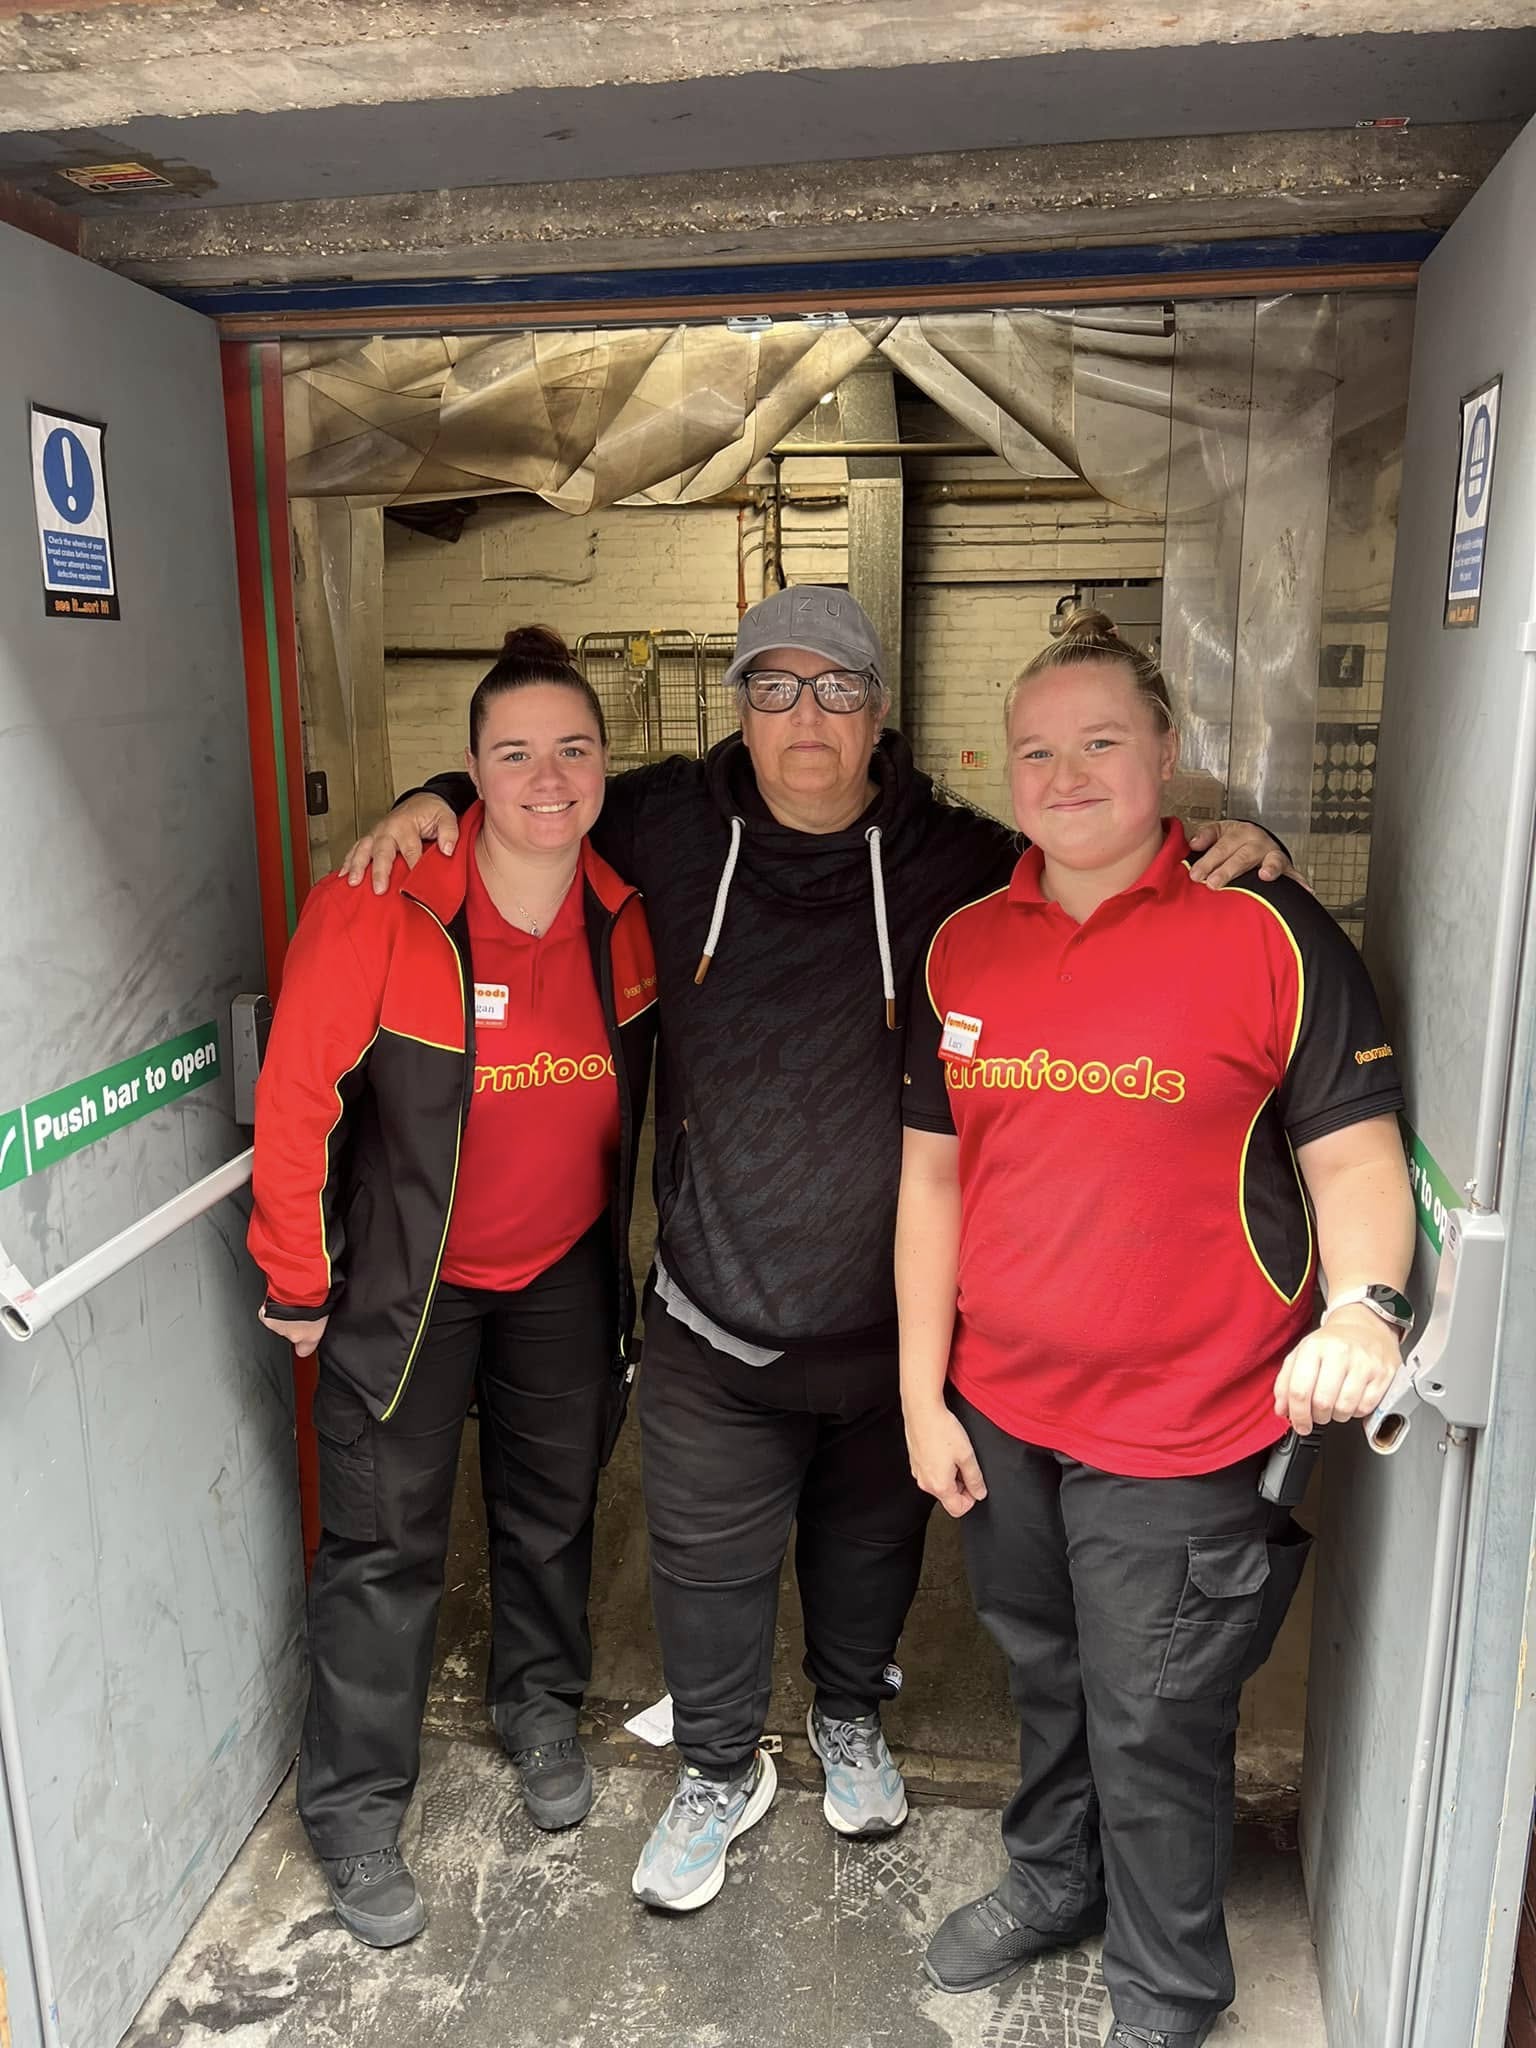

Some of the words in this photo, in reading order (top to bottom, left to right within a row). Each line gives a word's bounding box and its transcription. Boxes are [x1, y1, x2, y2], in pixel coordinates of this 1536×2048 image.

[48, 536, 62, 545] Check
[63, 538, 71, 546] the
[72, 539, 87, 548] wheels
[53, 558, 67, 567] Never
[68, 561, 85, 570] attempt
[57, 570, 77, 579] defective
[78, 574, 101, 582] equipment
[945, 1048, 1186, 1104] armfoods
[33, 1095, 98, 1150] Push
[102, 1076, 140, 1117] bar
[145, 1065, 166, 1094] to
[171, 1042, 217, 1084] open
[1421, 1168, 1433, 1212] to
